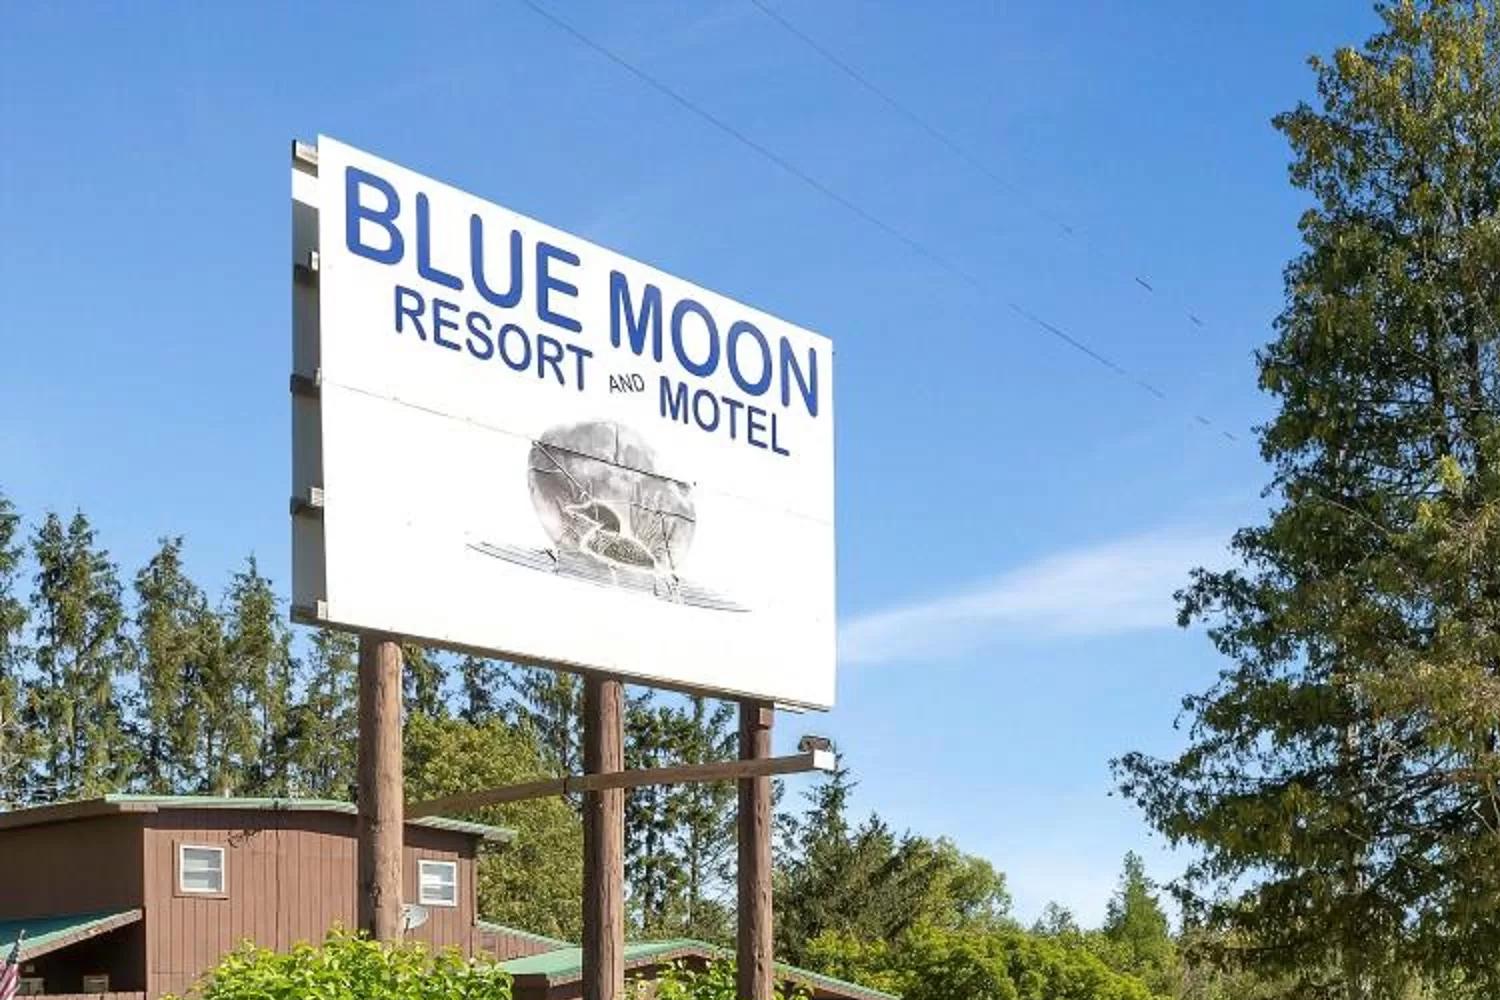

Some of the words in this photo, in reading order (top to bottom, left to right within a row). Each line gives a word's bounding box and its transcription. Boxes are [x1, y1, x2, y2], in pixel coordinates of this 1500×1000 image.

[345, 166, 582, 333] BLUE
[610, 270, 818, 417] MOON
[395, 285, 593, 391] RESORT
[609, 374, 645, 393] AND
[660, 376, 789, 456] MOTEL
